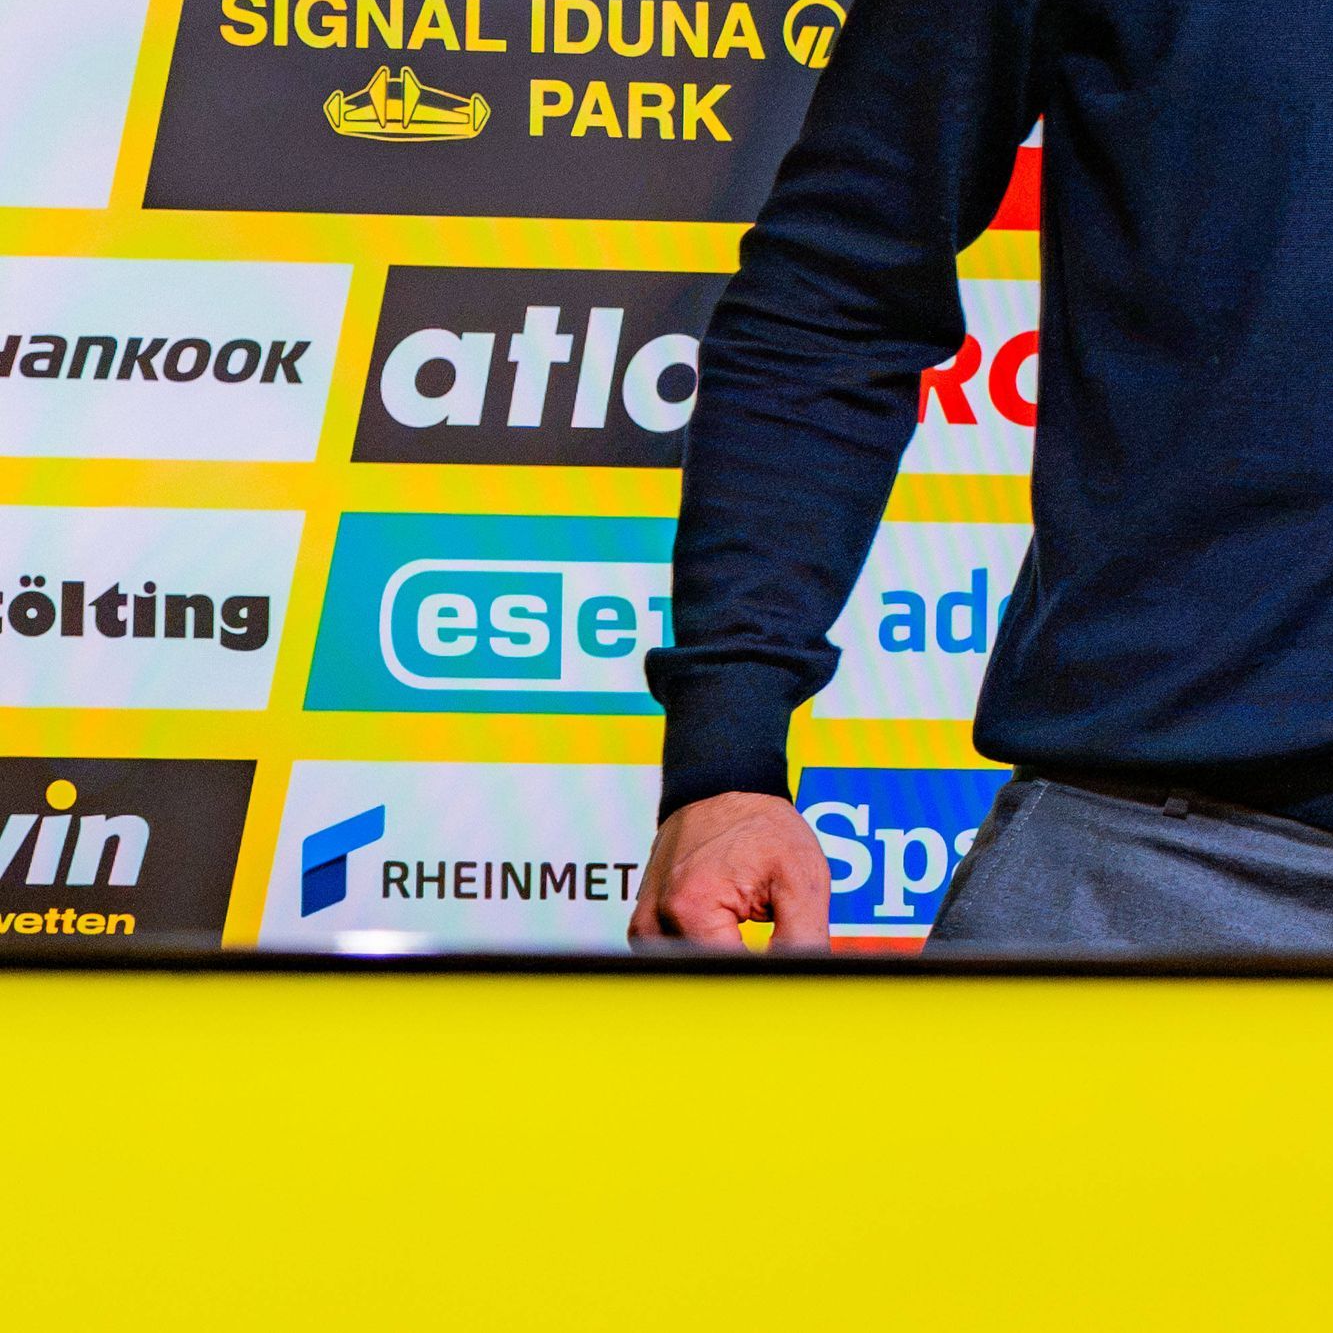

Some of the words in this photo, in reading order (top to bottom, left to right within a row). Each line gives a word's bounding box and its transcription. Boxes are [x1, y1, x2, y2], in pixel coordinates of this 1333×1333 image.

[529, 79, 733, 142] PARK
[0, 575, 270, 652] ölting
[879, 567, 1012, 654] ad
[382, 860, 642, 902] RHEINMET
